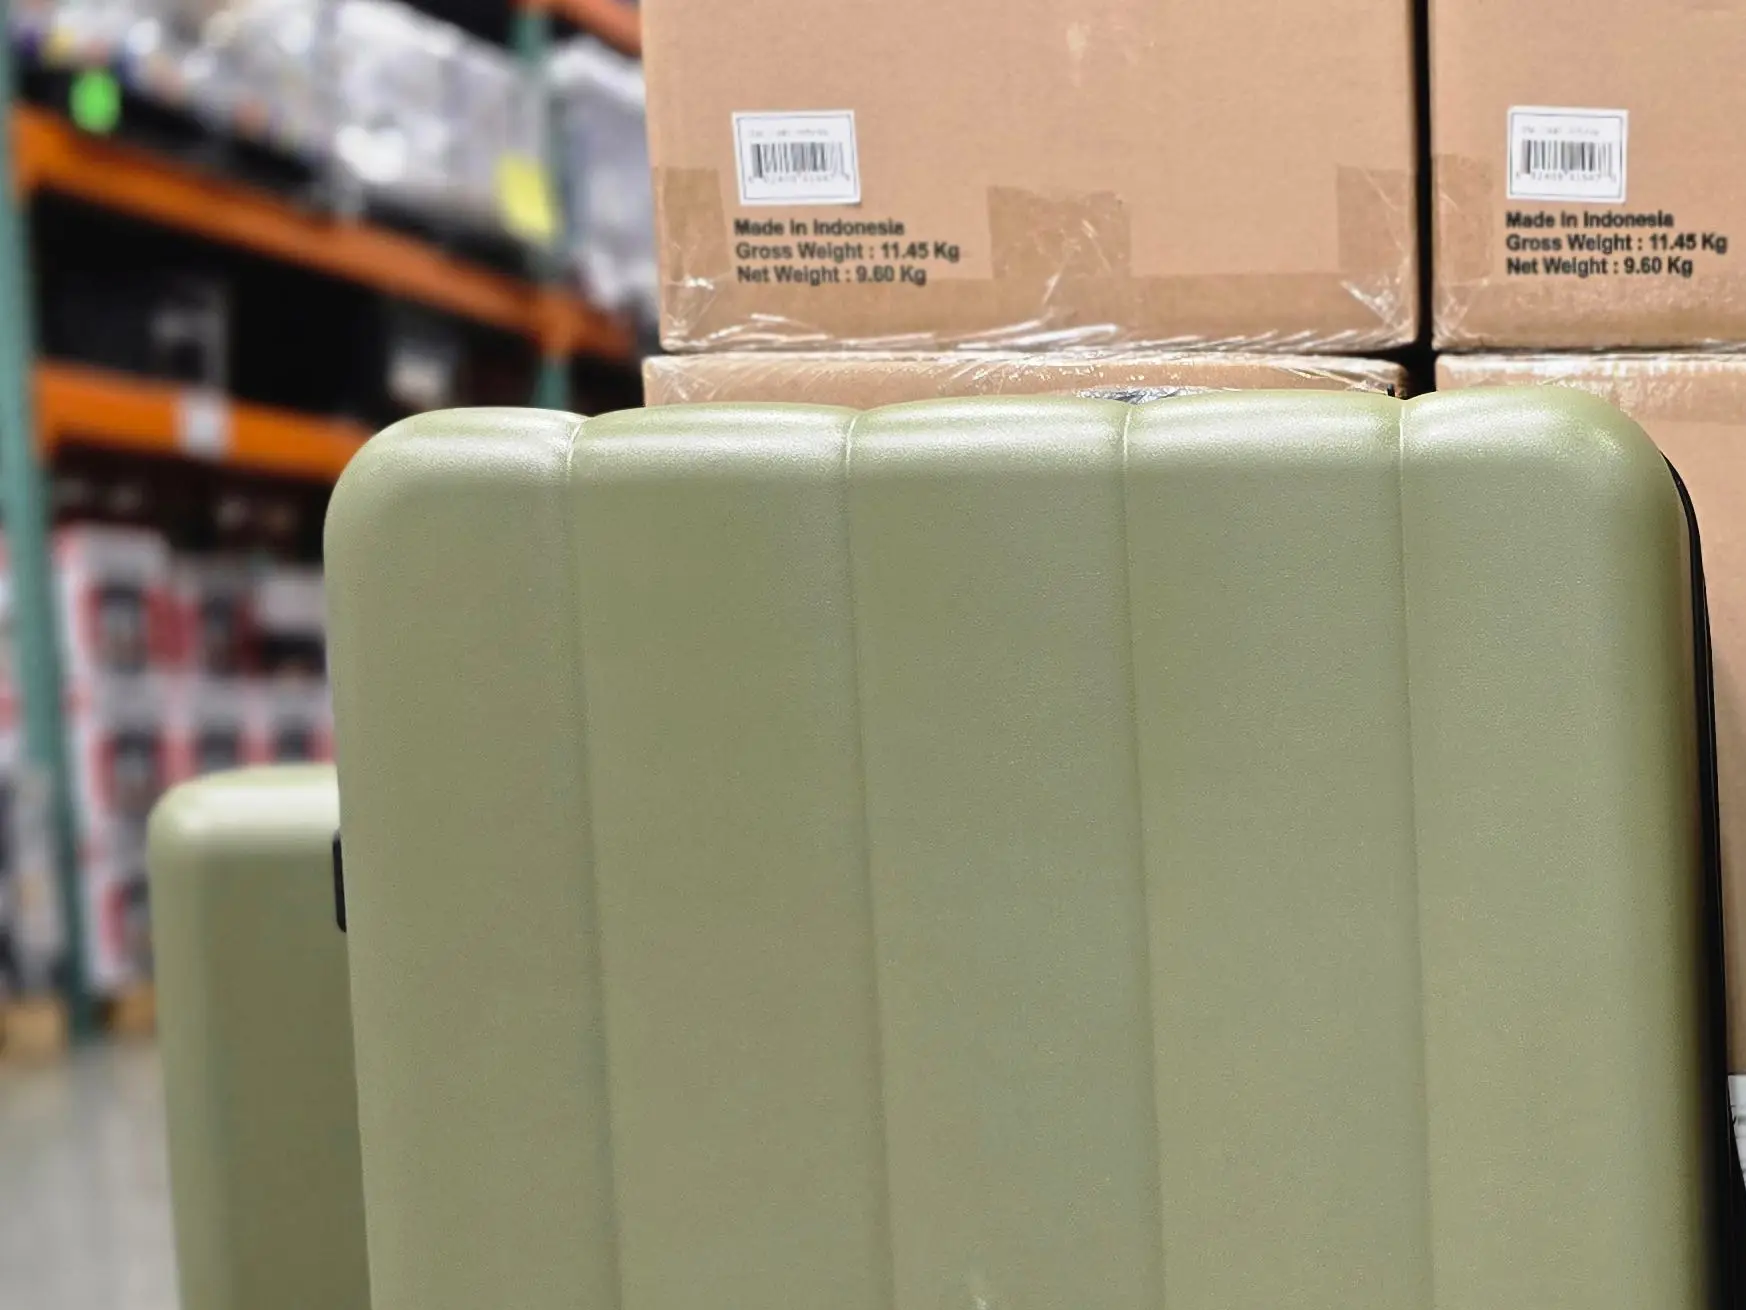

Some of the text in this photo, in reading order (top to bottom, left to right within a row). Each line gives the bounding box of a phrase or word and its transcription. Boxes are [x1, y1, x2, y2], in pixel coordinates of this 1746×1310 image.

[734, 218, 784, 236] Made
[813, 218, 905, 236] Indonesia
[1506, 211, 1555, 228] Made
[1584, 210, 1674, 228] Indonesia
[735, 242, 793, 260] Gross
[797, 241, 864, 264] Weight
[881, 242, 929, 259] 11.45
[934, 241, 960, 263] Kg
[1505, 234, 1562, 251] Gross
[1566, 233, 1632, 255] Weight
[1649, 233, 1697, 251] 11.45
[1701, 233, 1728, 255] Kg
[737, 266, 770, 283] Net
[773, 265, 840, 286] Weight
[856, 265, 895, 283] 9.60
[900, 266, 927, 287] Kg
[1506, 257, 1538, 275] Net
[1542, 257, 1608, 278] Weight
[1624, 257, 1663, 274] 9.60
[1668, 256, 1693, 278] Kg
